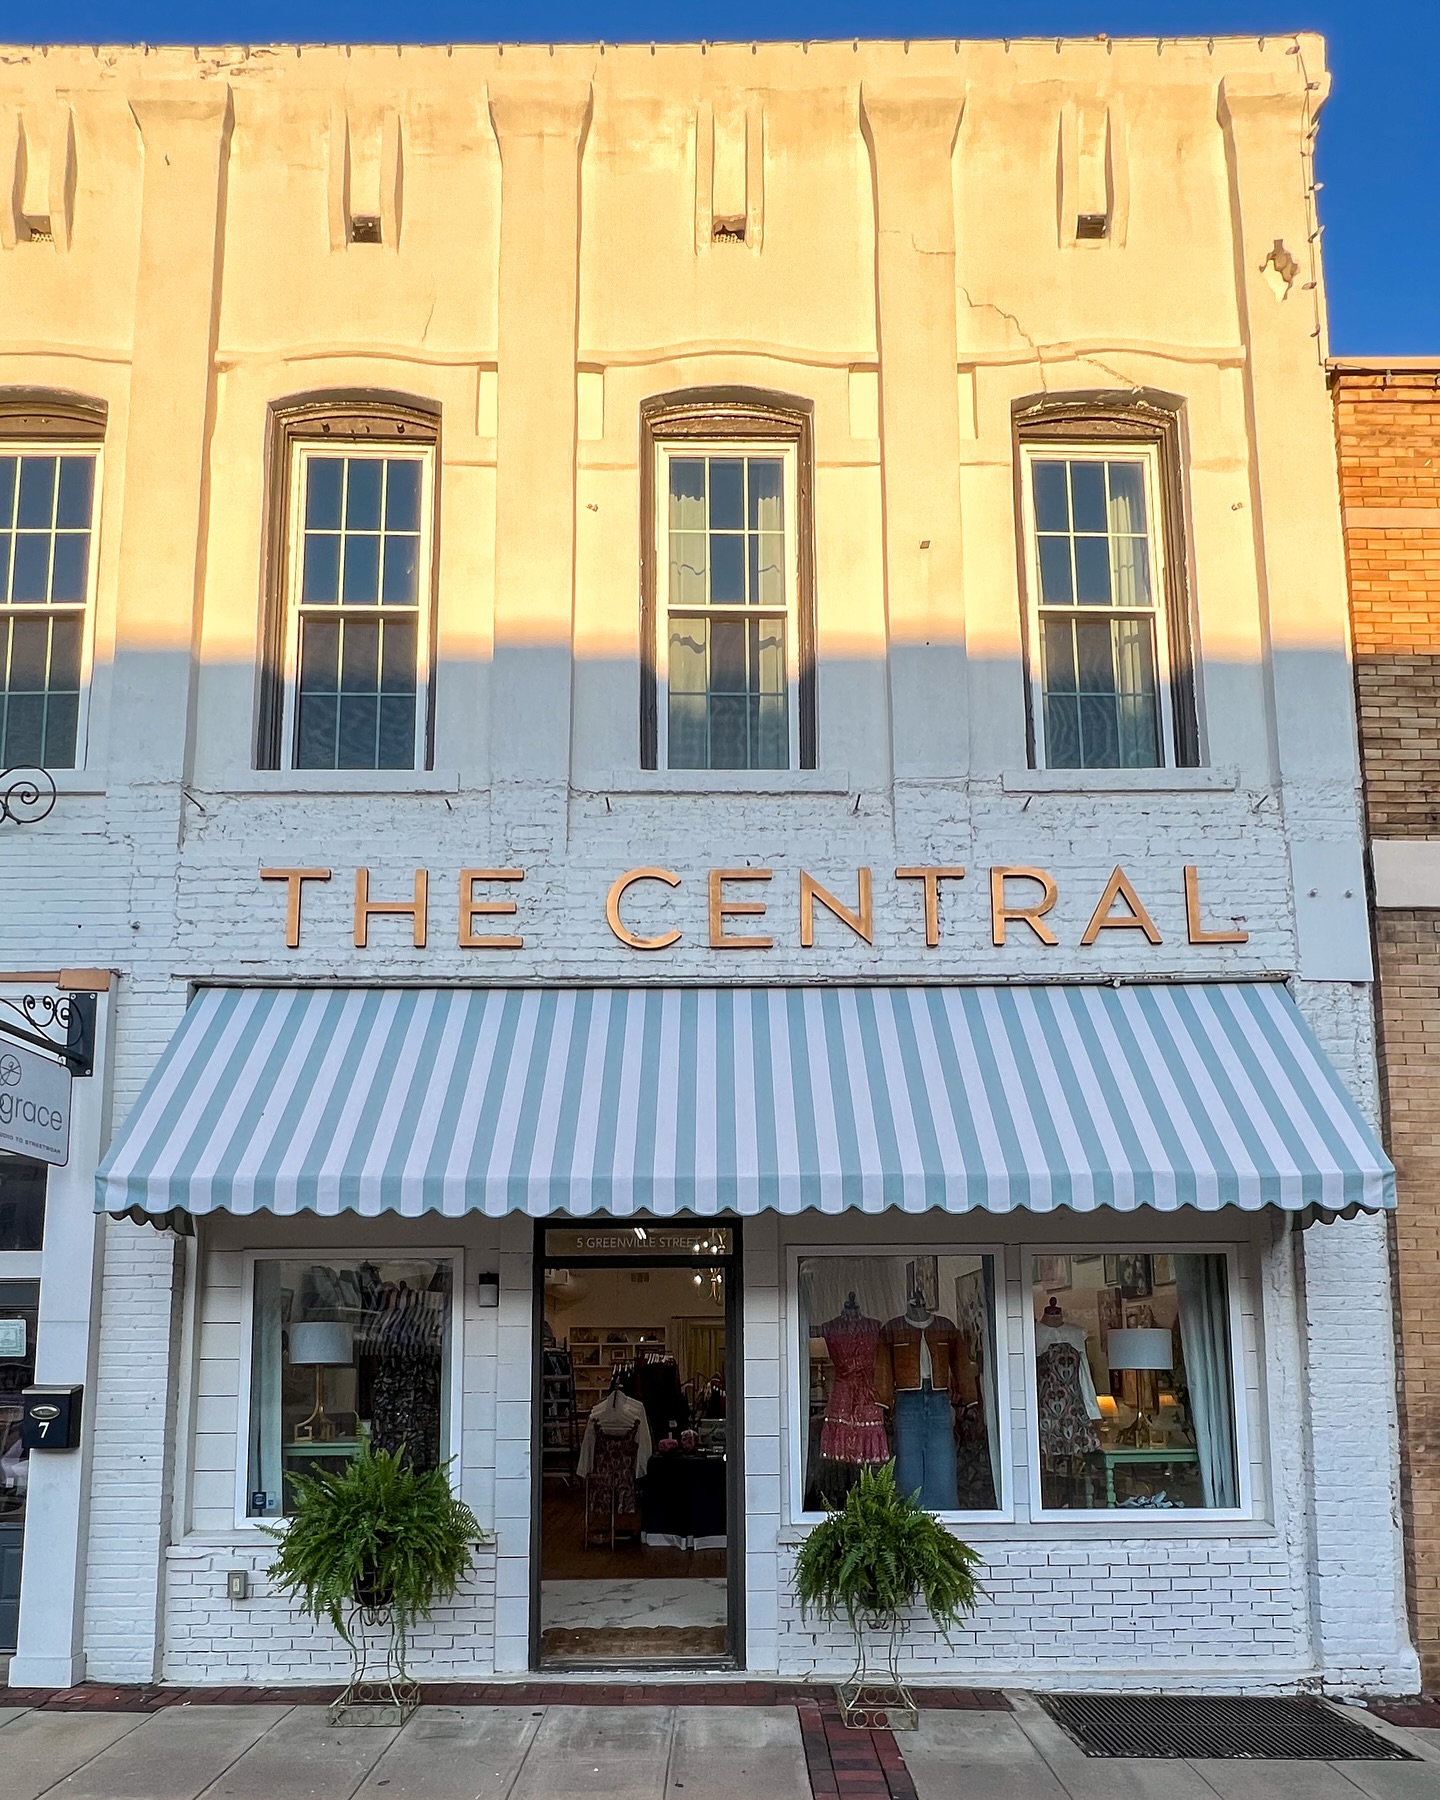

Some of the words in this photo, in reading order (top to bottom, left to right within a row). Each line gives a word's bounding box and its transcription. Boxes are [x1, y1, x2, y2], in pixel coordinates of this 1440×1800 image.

[260, 868, 524, 948] THE
[606, 864, 1248, 949] CENTRAL
[15, 1136, 24, 1144] TO
[576, 1237, 583, 1249] 5
[586, 1237, 656, 1249] GREENVILLE
[659, 1236, 701, 1248] STREET
[38, 1421, 50, 1439] 7
